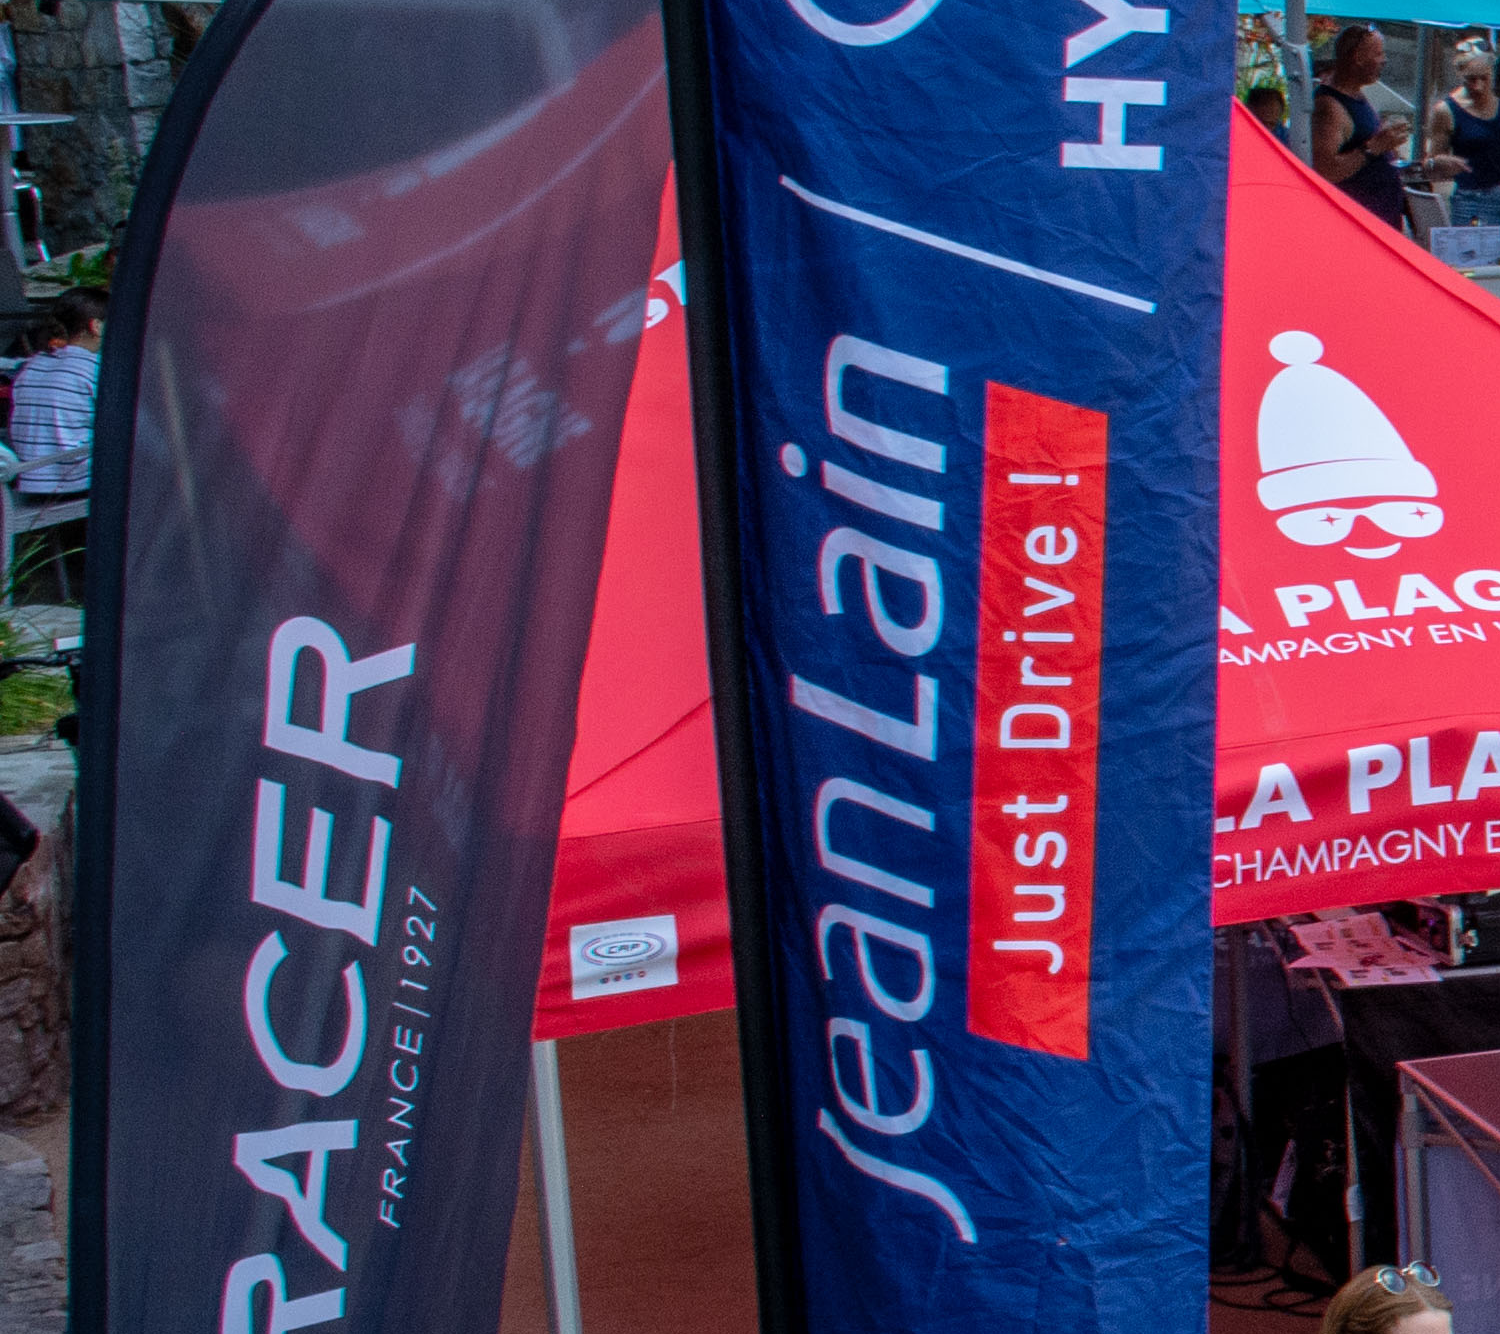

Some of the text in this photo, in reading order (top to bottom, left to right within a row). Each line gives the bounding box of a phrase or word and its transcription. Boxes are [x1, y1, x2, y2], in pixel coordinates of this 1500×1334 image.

[1001, 521, 1079, 753] Drive
[1427, 621, 1482, 645] EN
[992, 793, 1067, 976] Just
